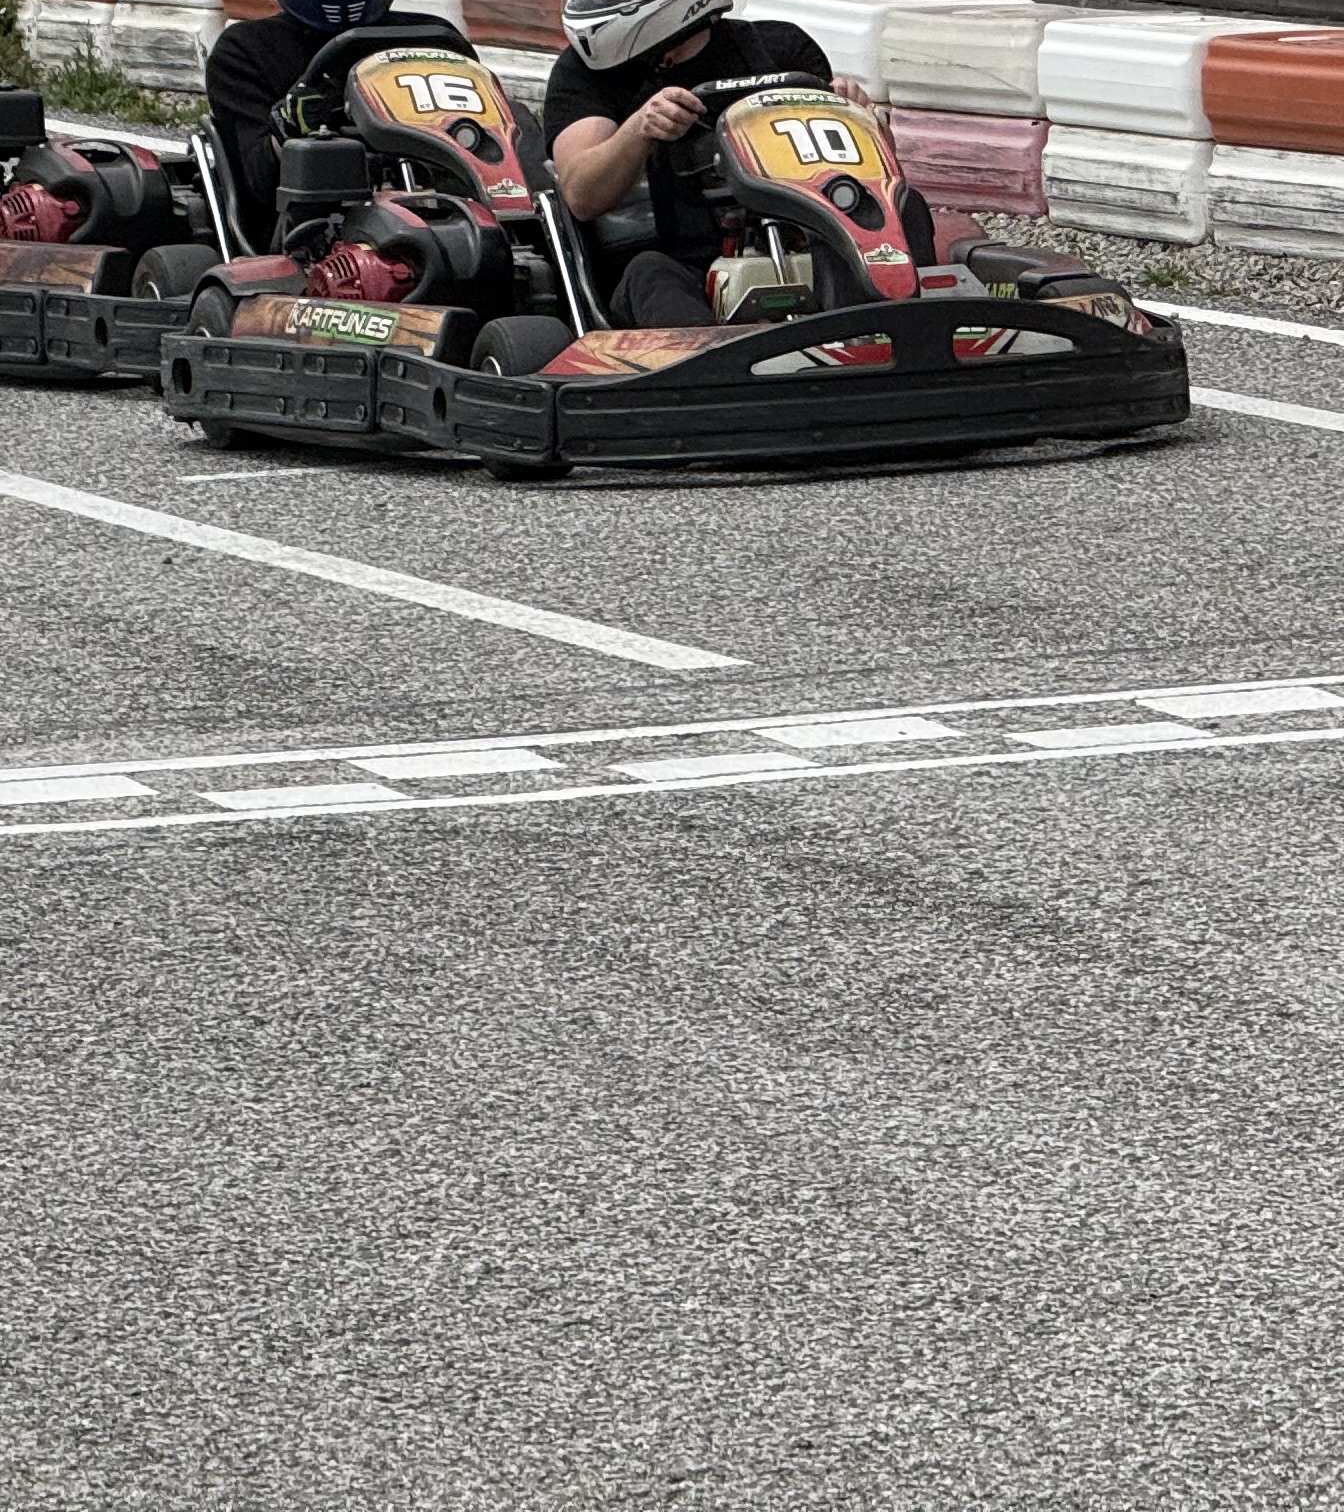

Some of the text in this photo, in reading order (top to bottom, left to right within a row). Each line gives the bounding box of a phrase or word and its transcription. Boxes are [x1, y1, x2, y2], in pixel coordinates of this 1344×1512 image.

[396, 74, 485, 113] 16
[716, 72, 790, 90] birelART
[771, 118, 863, 165] 10
[286, 299, 393, 339] KARTFUN.ES
